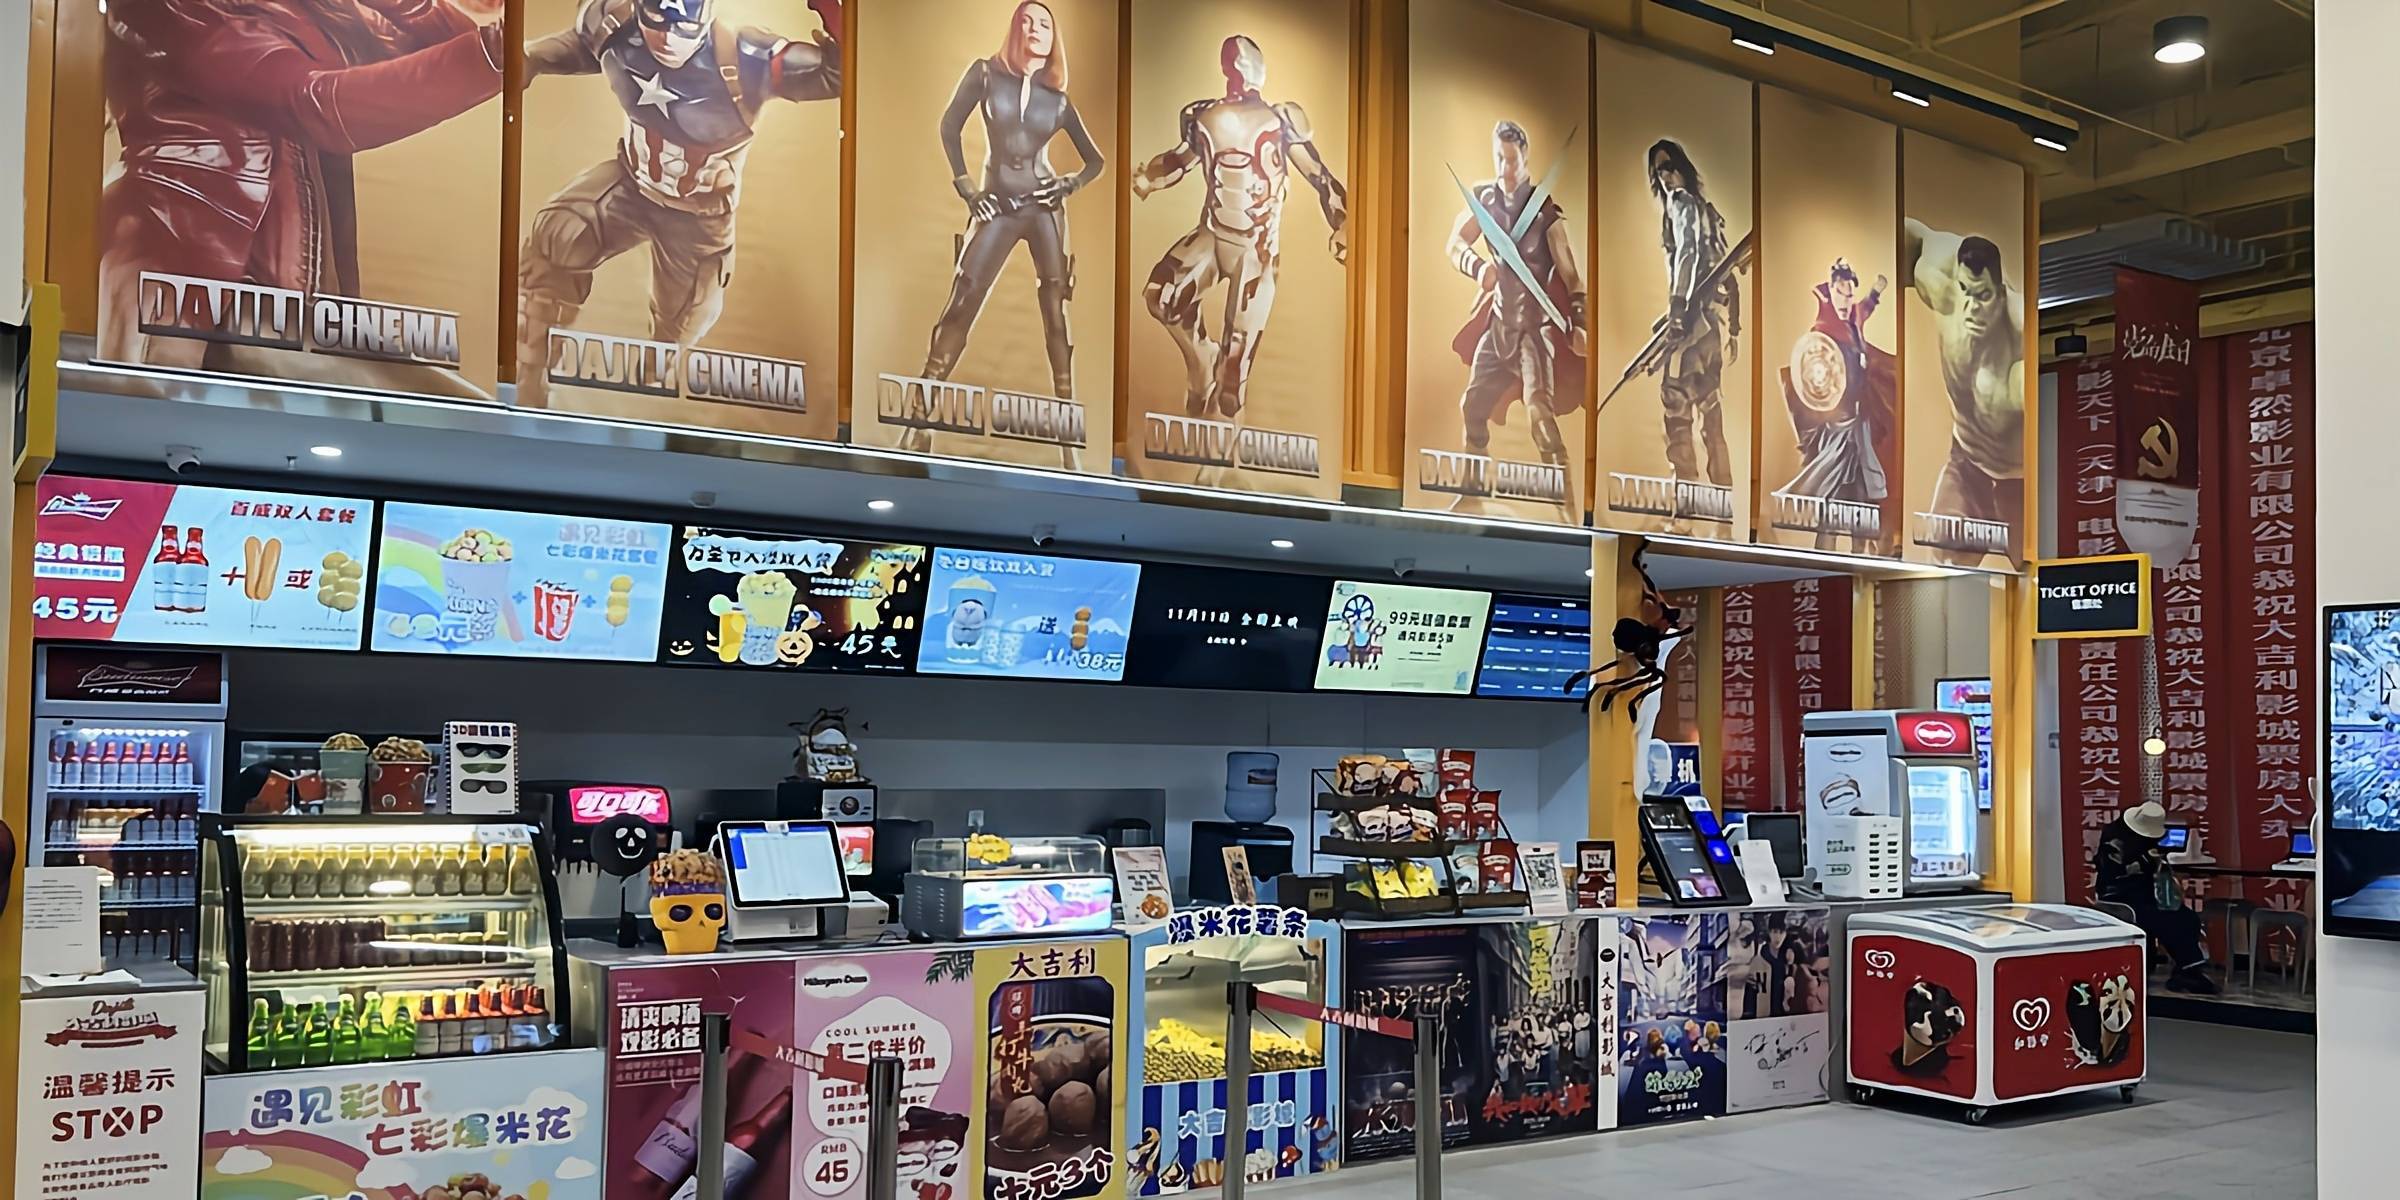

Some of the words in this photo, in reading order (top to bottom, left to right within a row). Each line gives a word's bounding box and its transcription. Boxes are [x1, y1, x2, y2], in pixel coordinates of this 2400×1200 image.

[138, 272, 304, 350] DAJILI
[311, 294, 460, 369] CINEMA
[547, 328, 680, 397] DAJILI
[686, 348, 806, 413] CINEMA
[878, 374, 985, 435] DAJILI
[990, 390, 1086, 448] CINEMA
[1145, 413, 1235, 467] DAJILI
[1238, 428, 1319, 477] CINEMA
[1420, 450, 1493, 494] DAJILI
[1494, 460, 1566, 503] CINEMA
[1608, 472, 1672, 515] DAJILI
[1674, 482, 1733, 522] CINEMA
[1825, 499, 1881, 538] CINEMA
[1963, 519, 2010, 555] CINEMA
[284, 569, 313, 590] 或
[2040, 585, 2085, 598] TICKET
[2089, 582, 2136, 596] OFFICE
[32, 596, 118, 624] 45元
[1038, 616, 1058, 636] 送
[1168, 908, 1307, 943] 爆米花薯条
[1009, 947, 1096, 979] 大吉利
[621, 1004, 701, 1030] 清爽啤酒
[825, 1028, 858, 1037] COOL
[865, 1022, 917, 1034] SUMMER
[1600, 971, 1616, 1077] 大吉利影城
[43, 1068, 175, 1099] 温馨提示
[250, 1079, 423, 1129] 遇见彩虹
[1178, 1100, 1296, 1139] 大吉影城
[52, 1105, 163, 1142] STOP
[366, 1106, 572, 1156] 七彩爆米花
[820, 1143, 847, 1154] RMB
[815, 1160, 848, 1184] 45
[994, 1150, 1113, 1200] 十元3个
